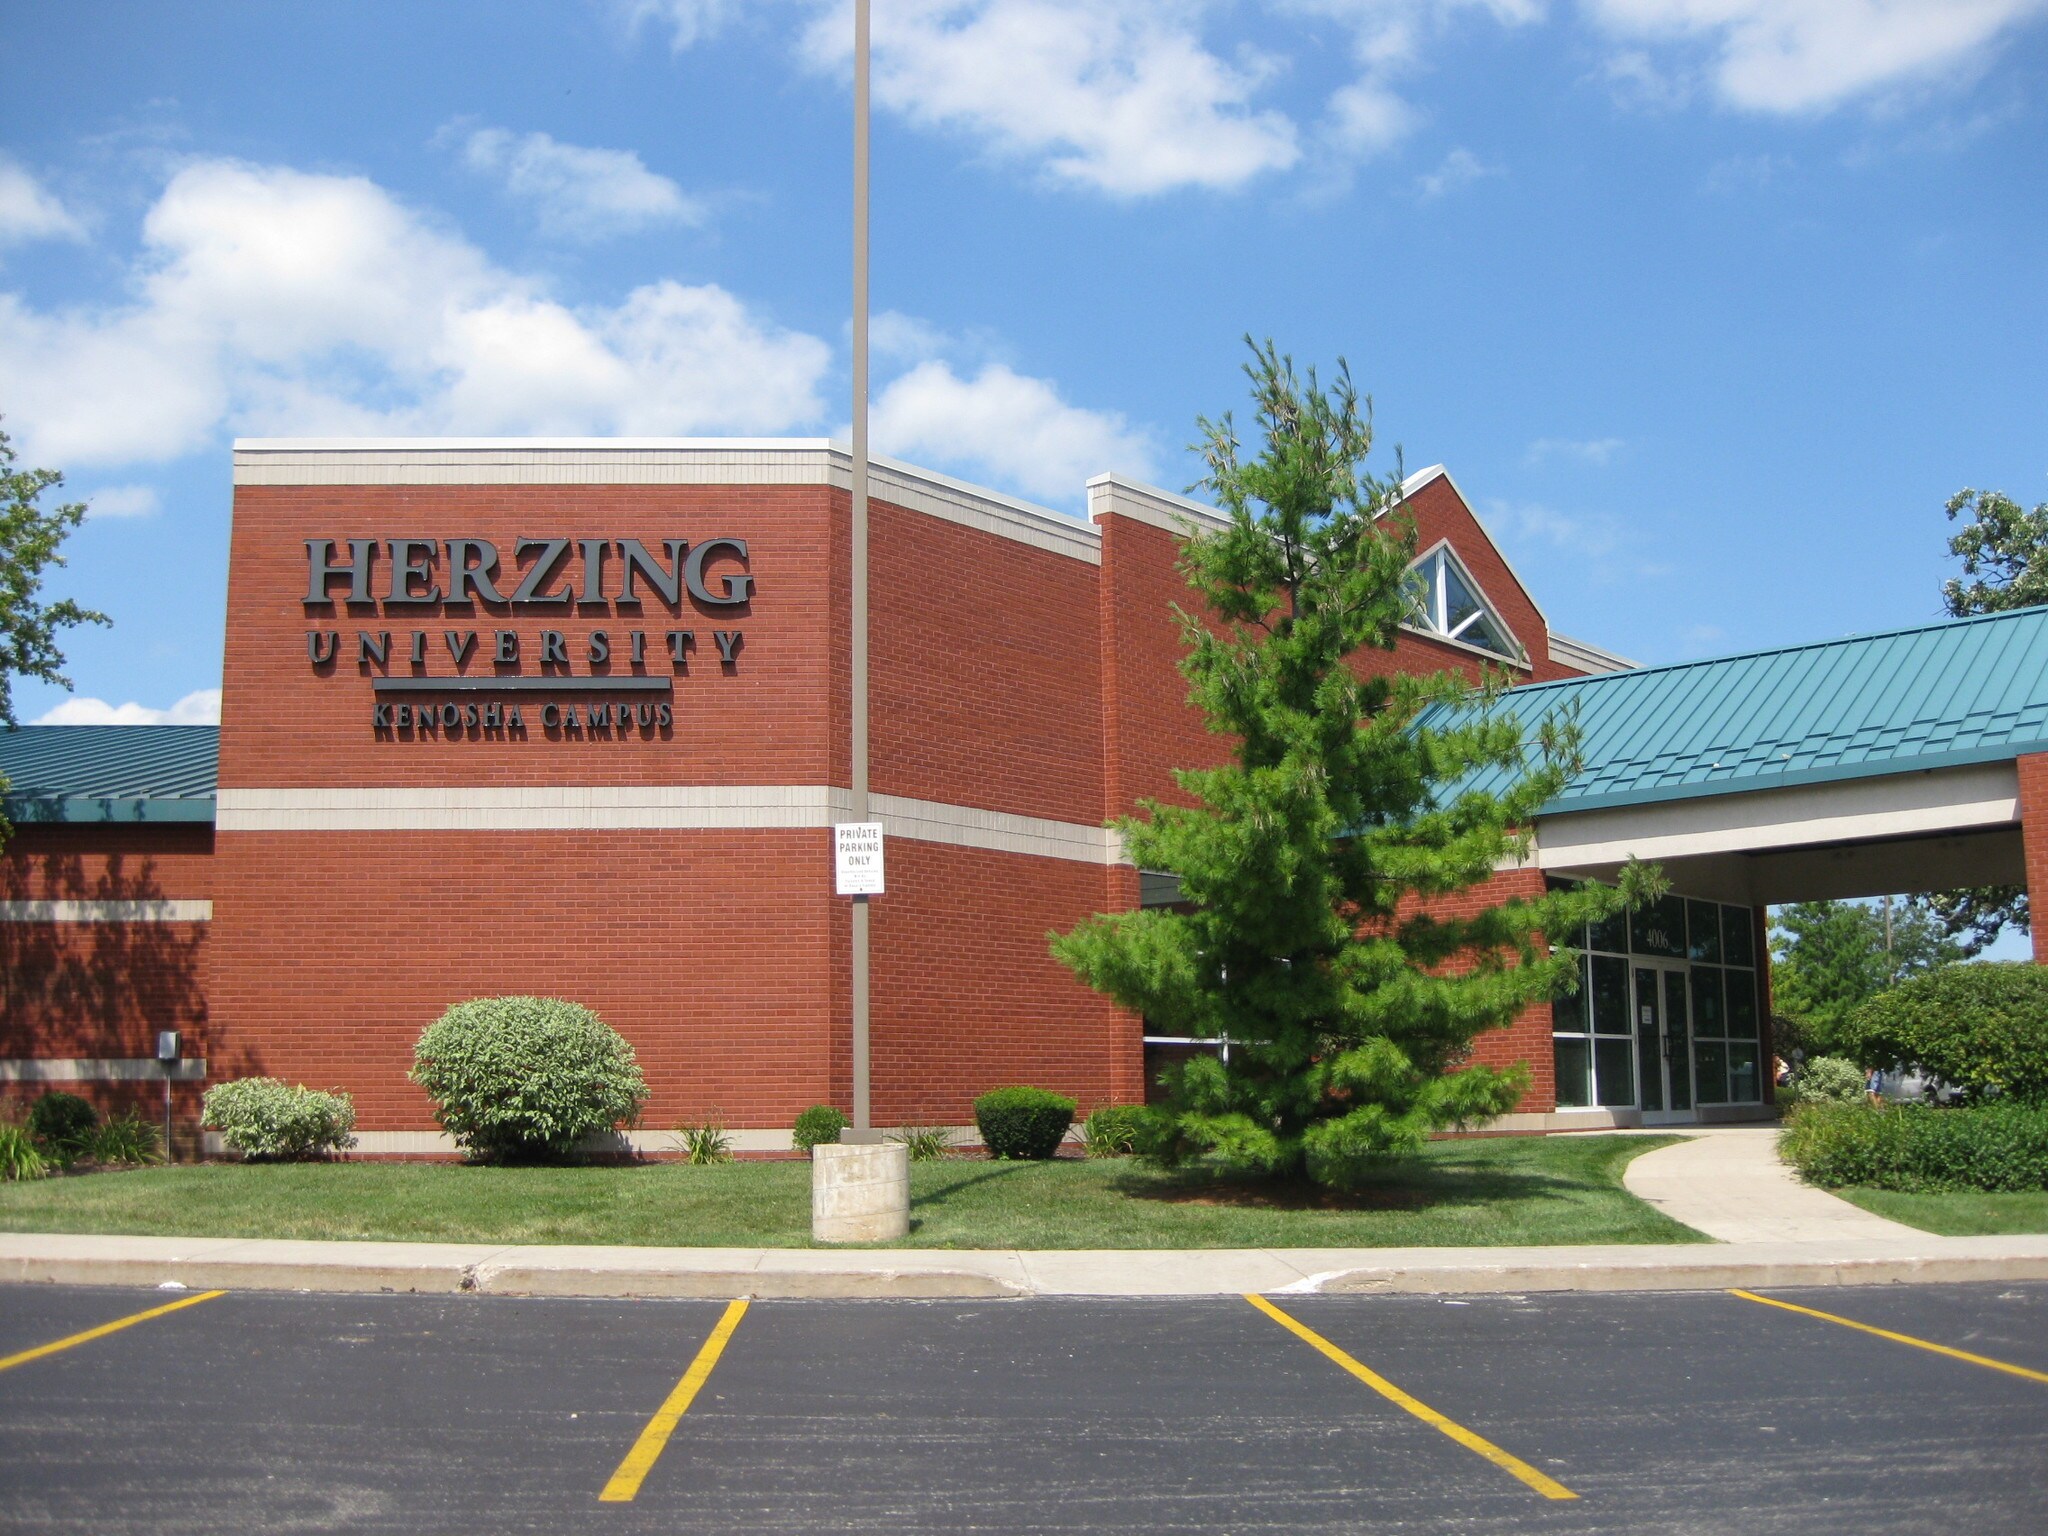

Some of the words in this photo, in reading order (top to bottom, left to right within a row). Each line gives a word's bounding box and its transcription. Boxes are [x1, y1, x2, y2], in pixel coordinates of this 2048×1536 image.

[301, 536, 754, 605] HERZING
[306, 630, 743, 663] UNIVERSITY
[371, 702, 525, 728] KENOSHA
[540, 702, 672, 727] CAMPUS
[840, 829, 878, 839] PRIVATE
[839, 842, 879, 852] PARKING
[848, 855, 871, 866] ONLY
[1646, 929, 1669, 949] 4006
